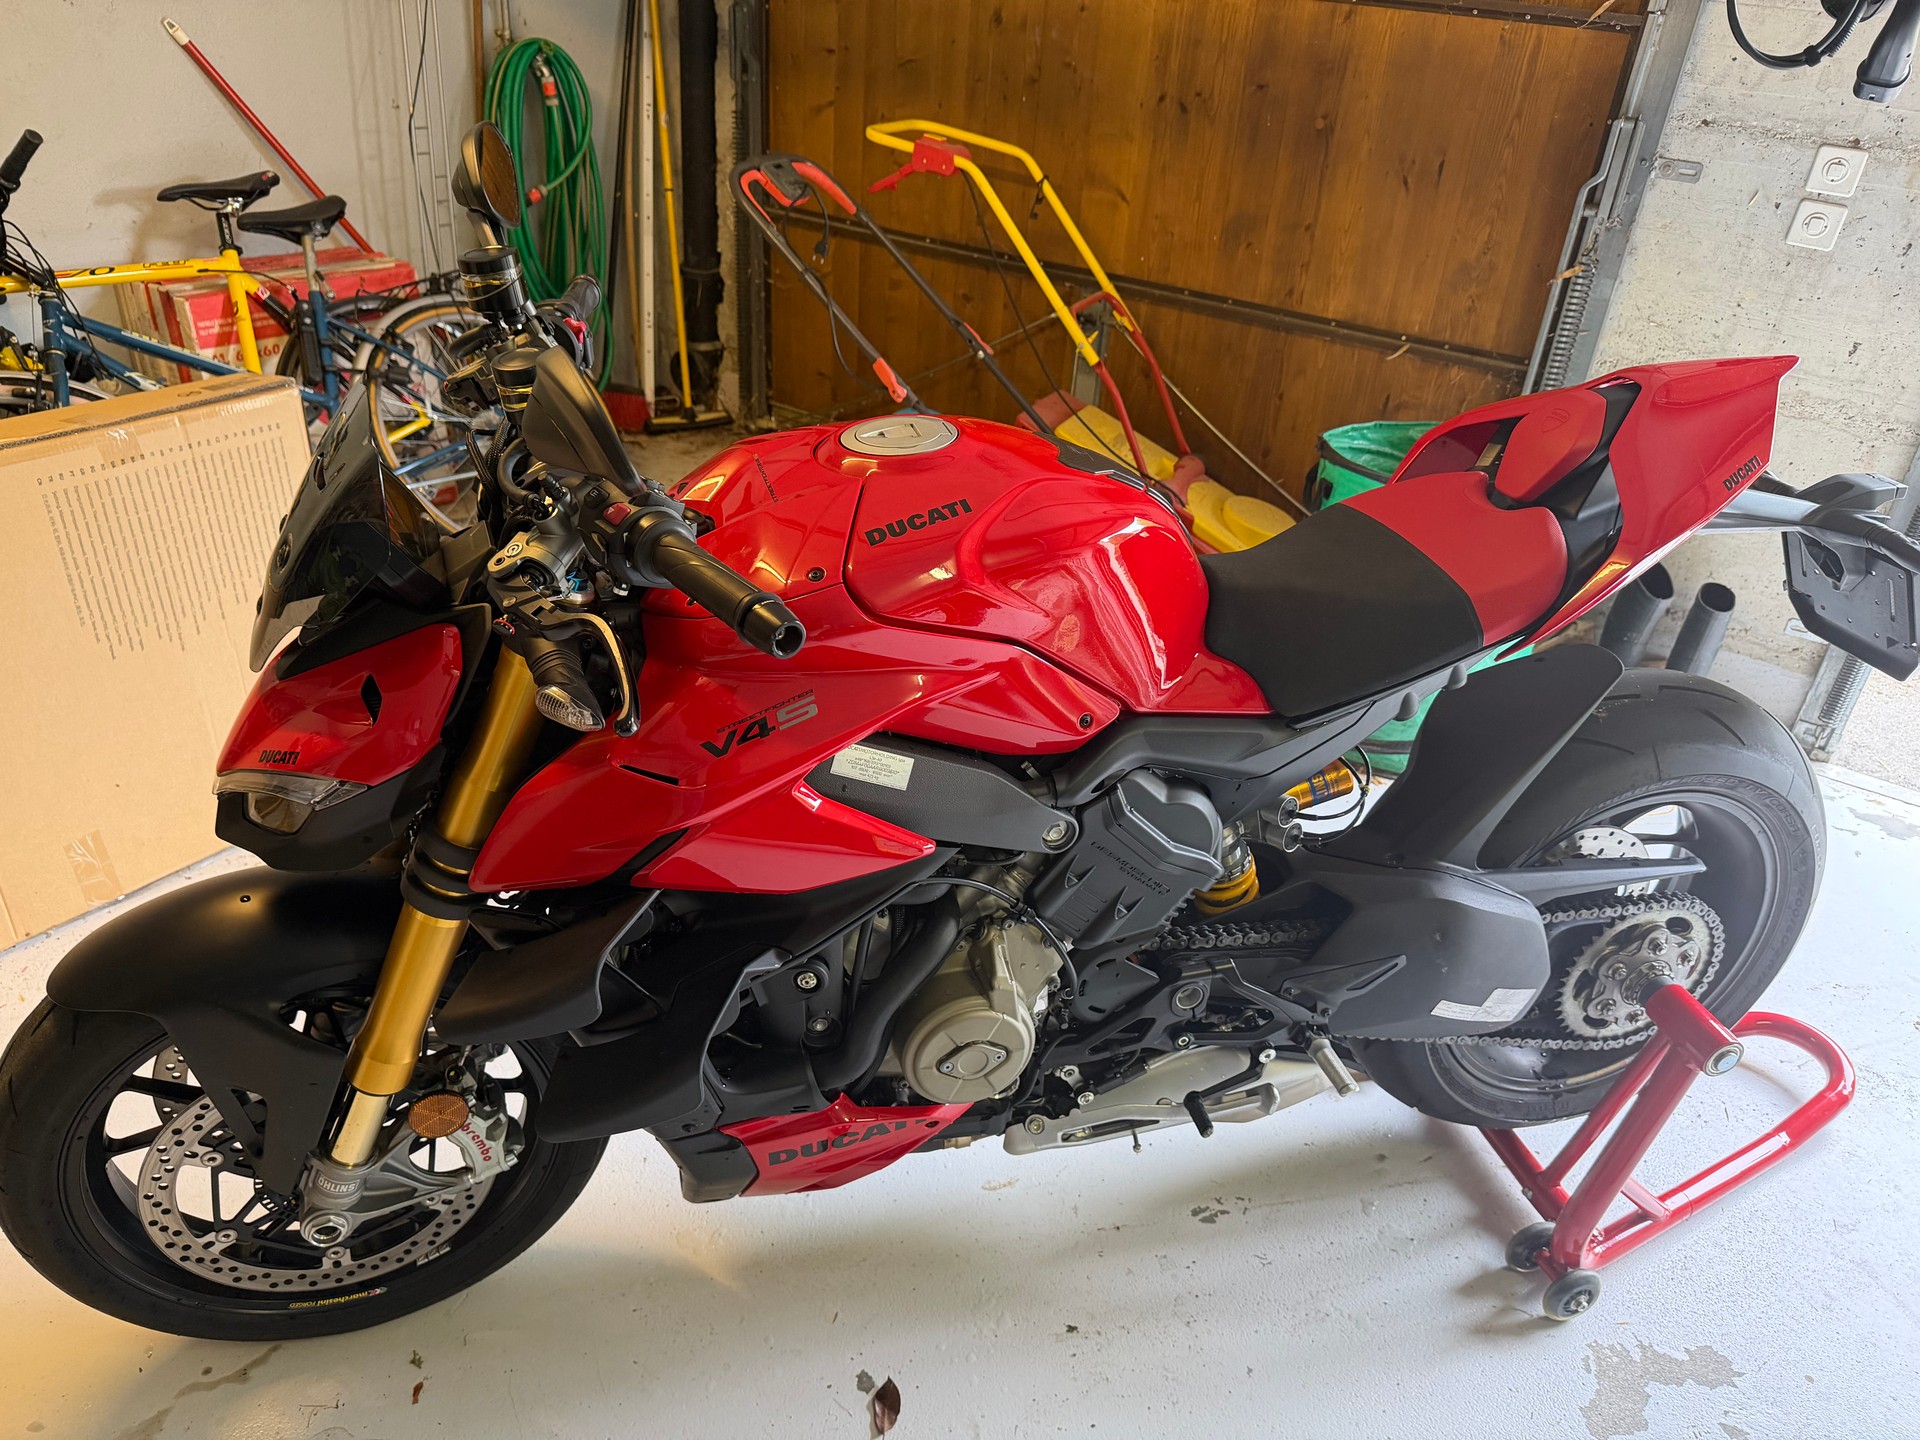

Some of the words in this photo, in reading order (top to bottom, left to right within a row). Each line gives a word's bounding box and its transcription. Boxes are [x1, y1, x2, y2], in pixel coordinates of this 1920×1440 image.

[1722, 455, 1762, 492] DUCATI
[864, 498, 973, 547] DUCATI
[717, 688, 814, 734] STREETFIGHTER
[258, 750, 300, 765] DUCATI
[461, 1122, 492, 1161] brembo
[768, 1118, 926, 1166] DUCAT
